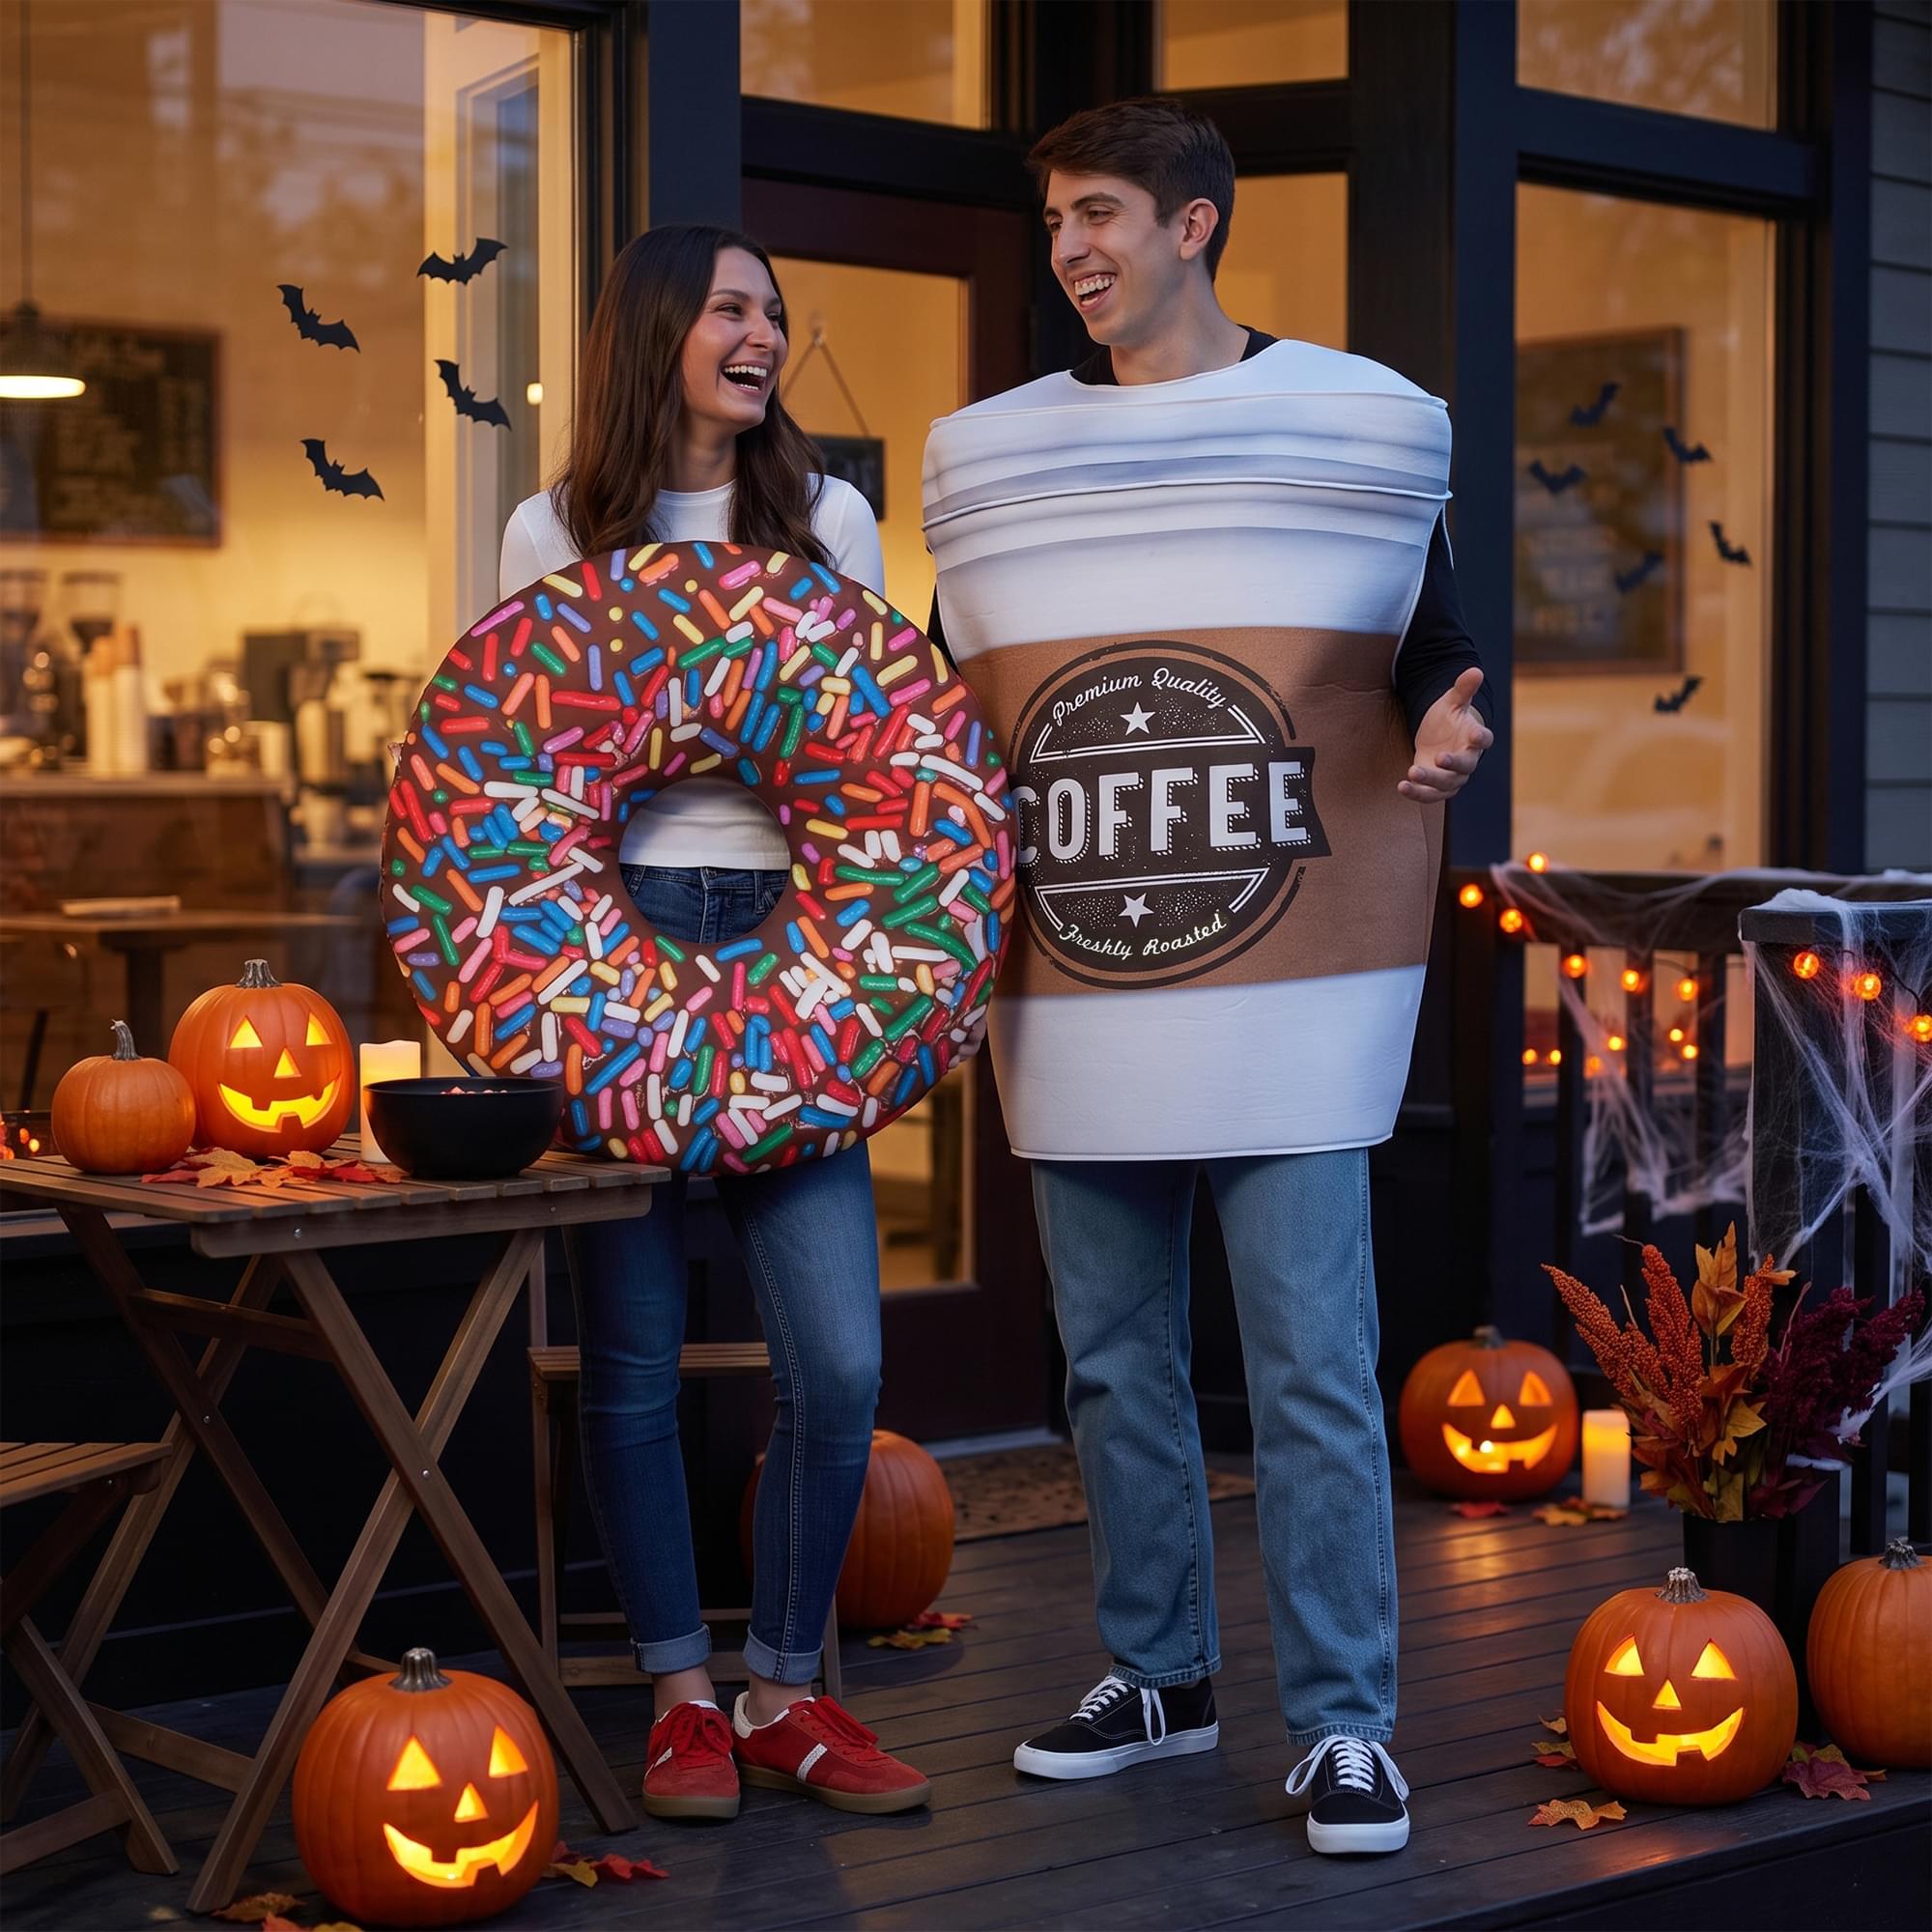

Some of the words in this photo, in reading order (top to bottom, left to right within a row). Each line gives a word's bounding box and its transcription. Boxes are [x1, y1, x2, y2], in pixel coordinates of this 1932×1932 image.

[1052, 674, 1142, 726] Premium
[1152, 667, 1227, 709] Quality
[1011, 761, 1312, 867] COFFEE
[1060, 923, 1133, 960] Freshly
[1143, 910, 1227, 956] Roasted
